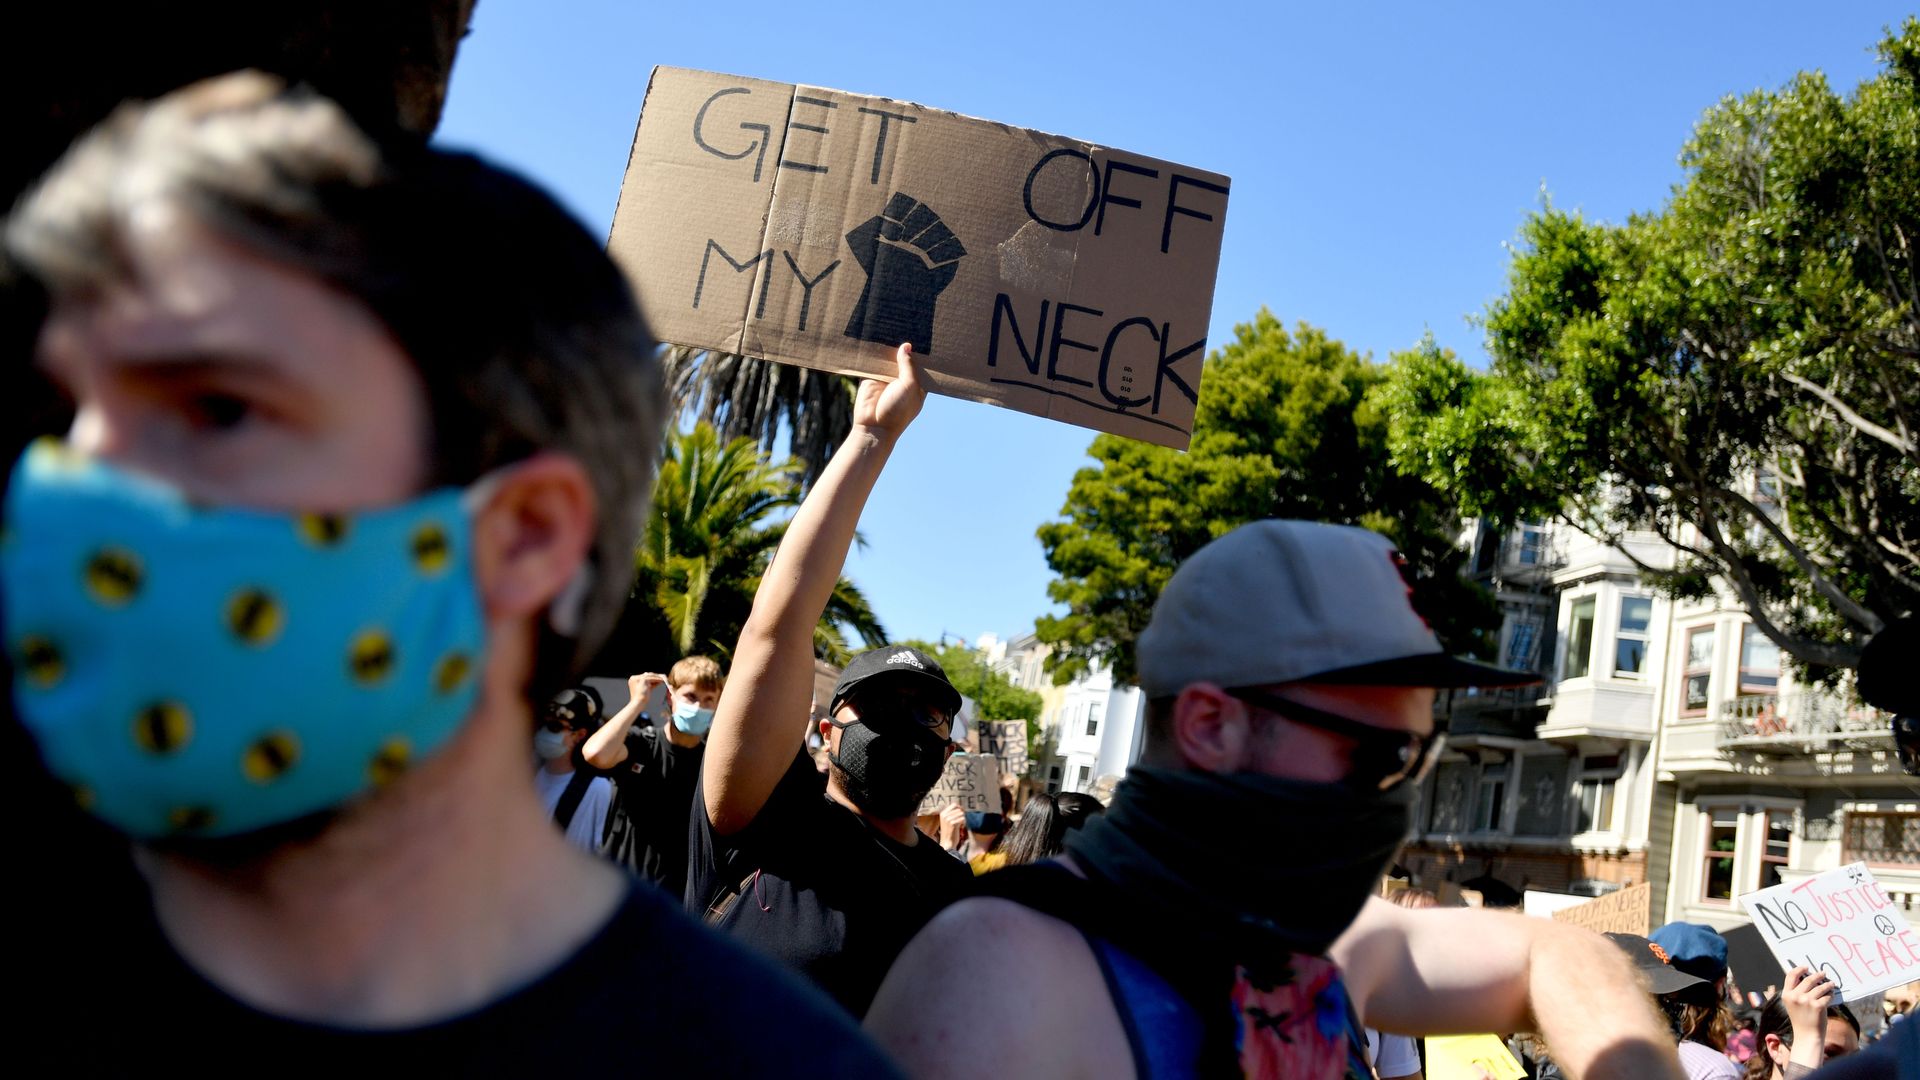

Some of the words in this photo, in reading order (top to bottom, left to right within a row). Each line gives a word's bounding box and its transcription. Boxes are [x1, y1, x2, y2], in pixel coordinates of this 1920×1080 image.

[692, 86, 918, 185] GET
[1022, 147, 1231, 254] OFF
[692, 238, 842, 332] MY
[987, 292, 1208, 415] NECK
[886, 654, 924, 670] adidas
[979, 738, 1027, 755] LIVES
[944, 761, 977, 776] ACK
[996, 755, 1030, 775] TTER
[921, 793, 990, 809] MATTER
[1613, 886, 1646, 913] NEVER
[1754, 896, 1809, 940] NO
[1791, 878, 1893, 928] JUSTICE
[1827, 929, 1920, 985] PEACE
